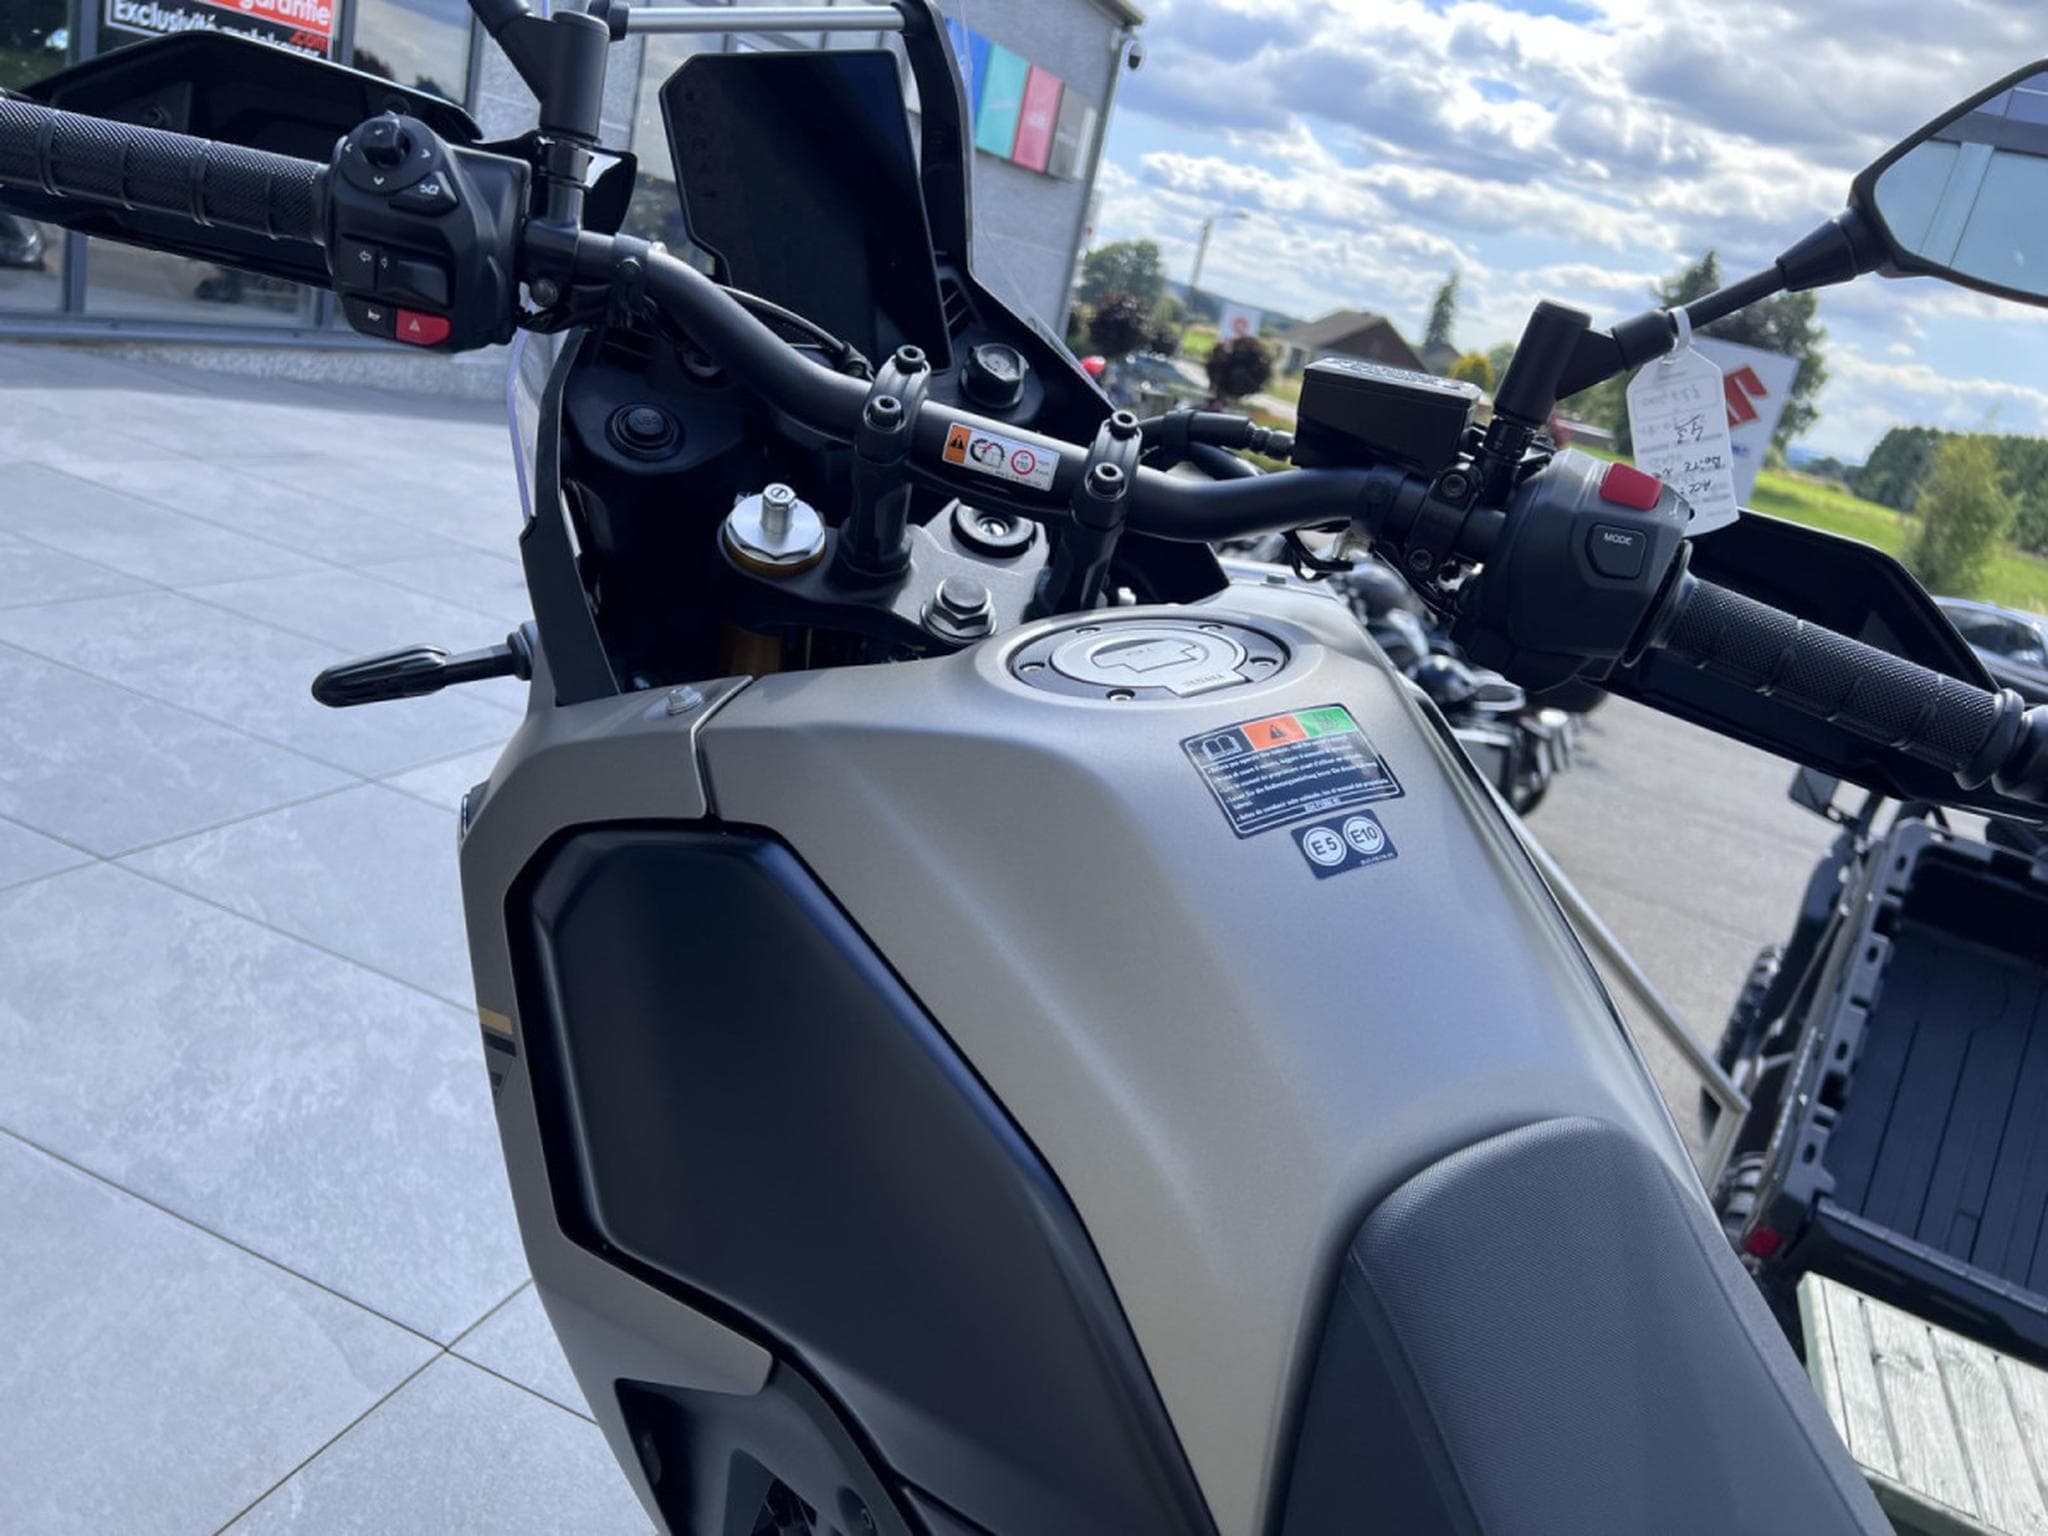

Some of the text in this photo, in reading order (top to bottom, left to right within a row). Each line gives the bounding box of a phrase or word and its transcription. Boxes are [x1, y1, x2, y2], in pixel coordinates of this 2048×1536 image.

[113, 0, 217, 32] Exclusivité
[1603, 532, 1633, 546] MODE
[1350, 826, 1378, 844] E10
